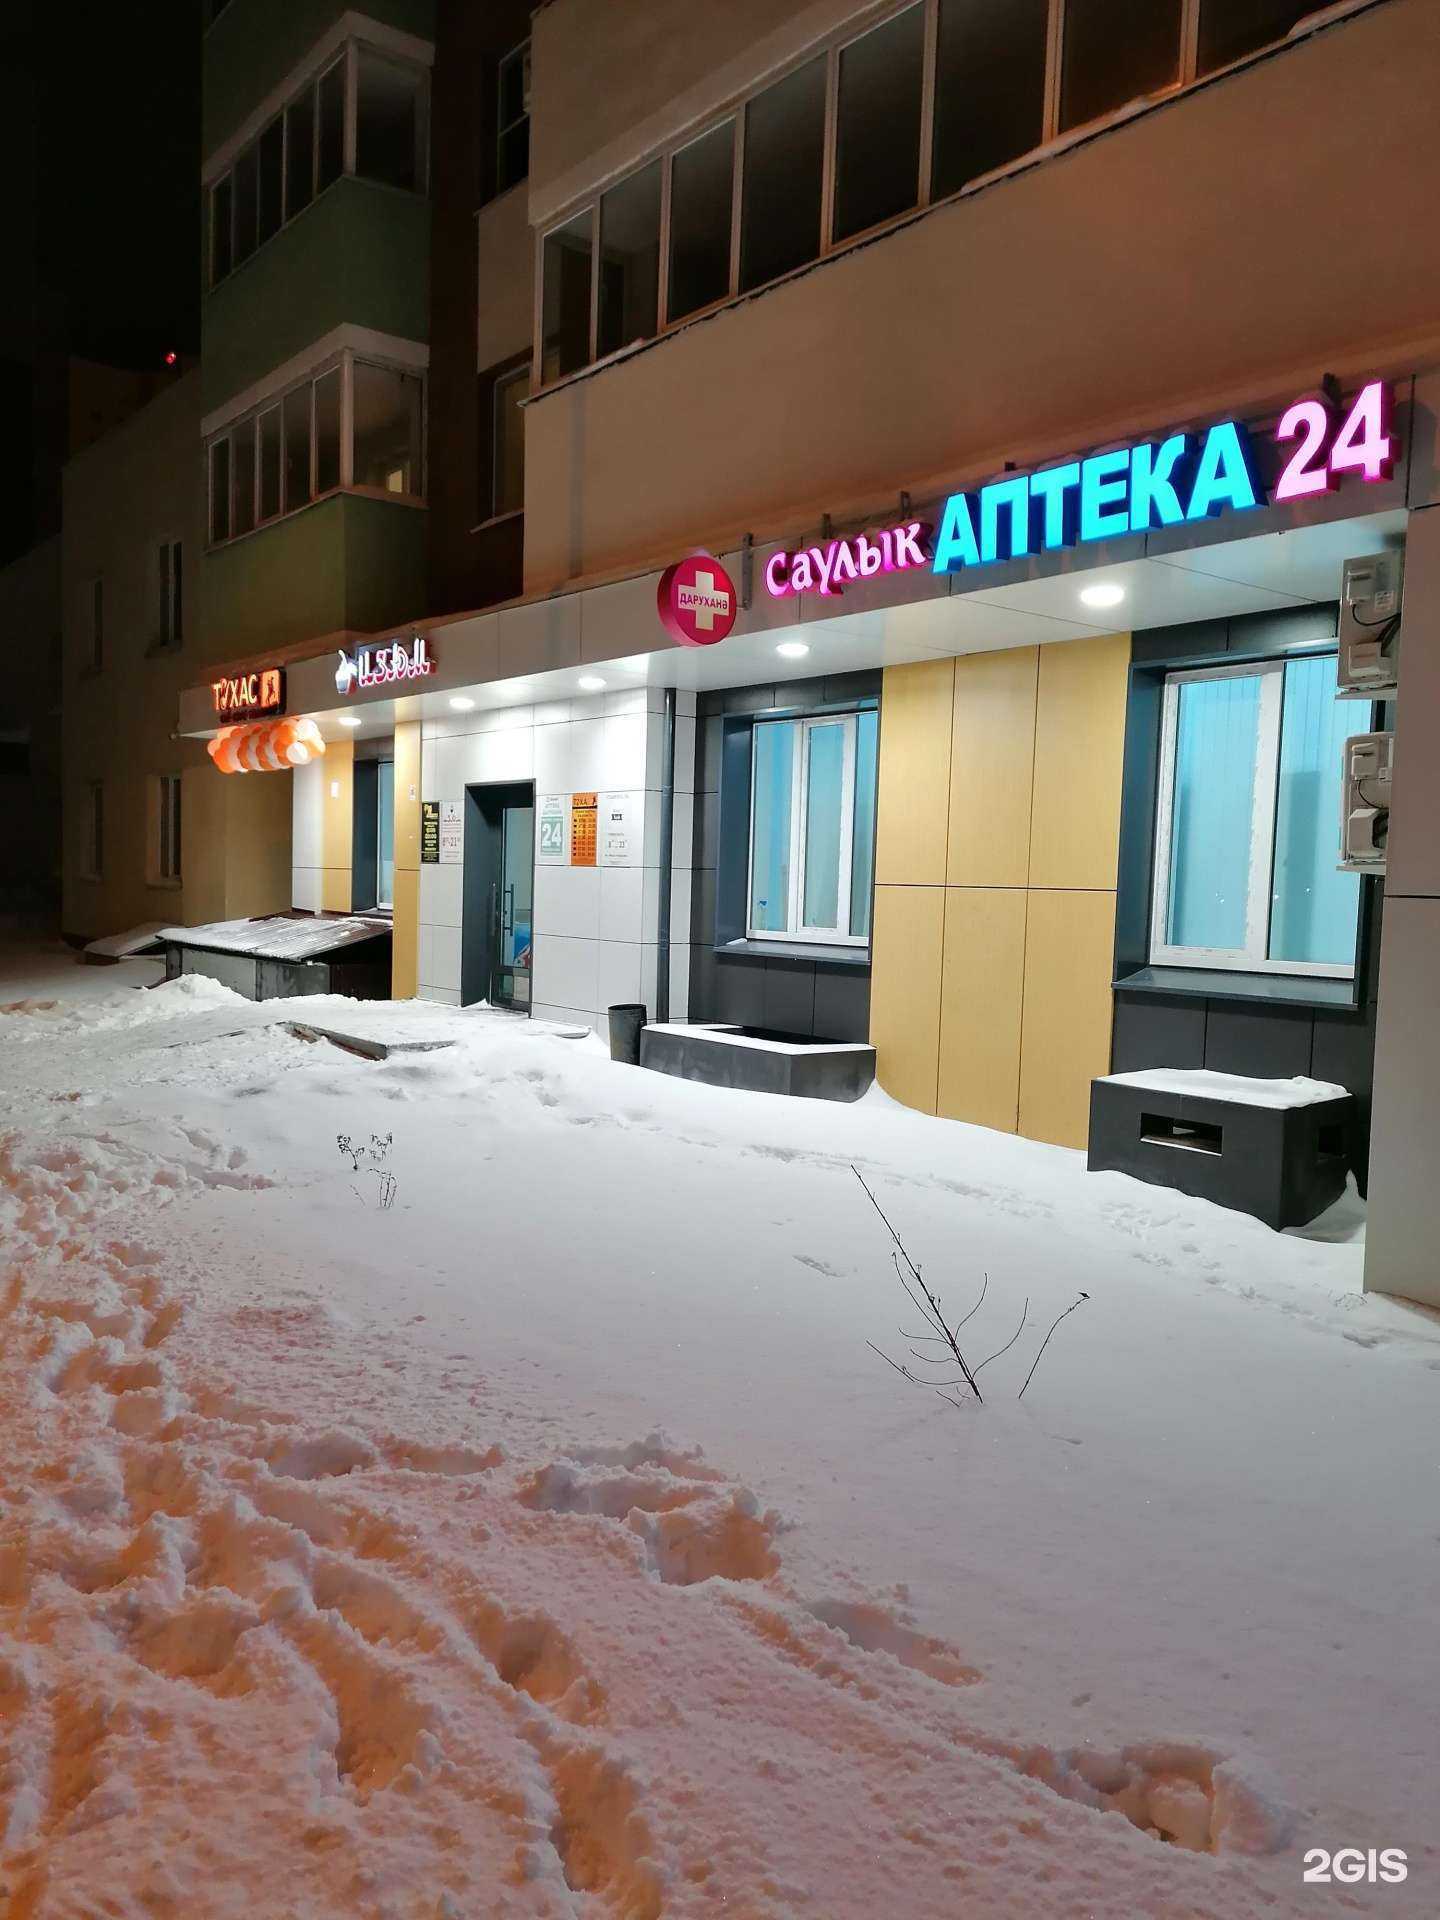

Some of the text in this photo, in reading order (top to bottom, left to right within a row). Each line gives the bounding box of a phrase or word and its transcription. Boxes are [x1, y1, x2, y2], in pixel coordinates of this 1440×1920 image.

[932, 420, 1260, 575] АПТЕКА
[1274, 379, 1391, 501] 24
[679, 592, 729, 610] ДАРУХАНӘ
[541, 822, 562, 848] 24
